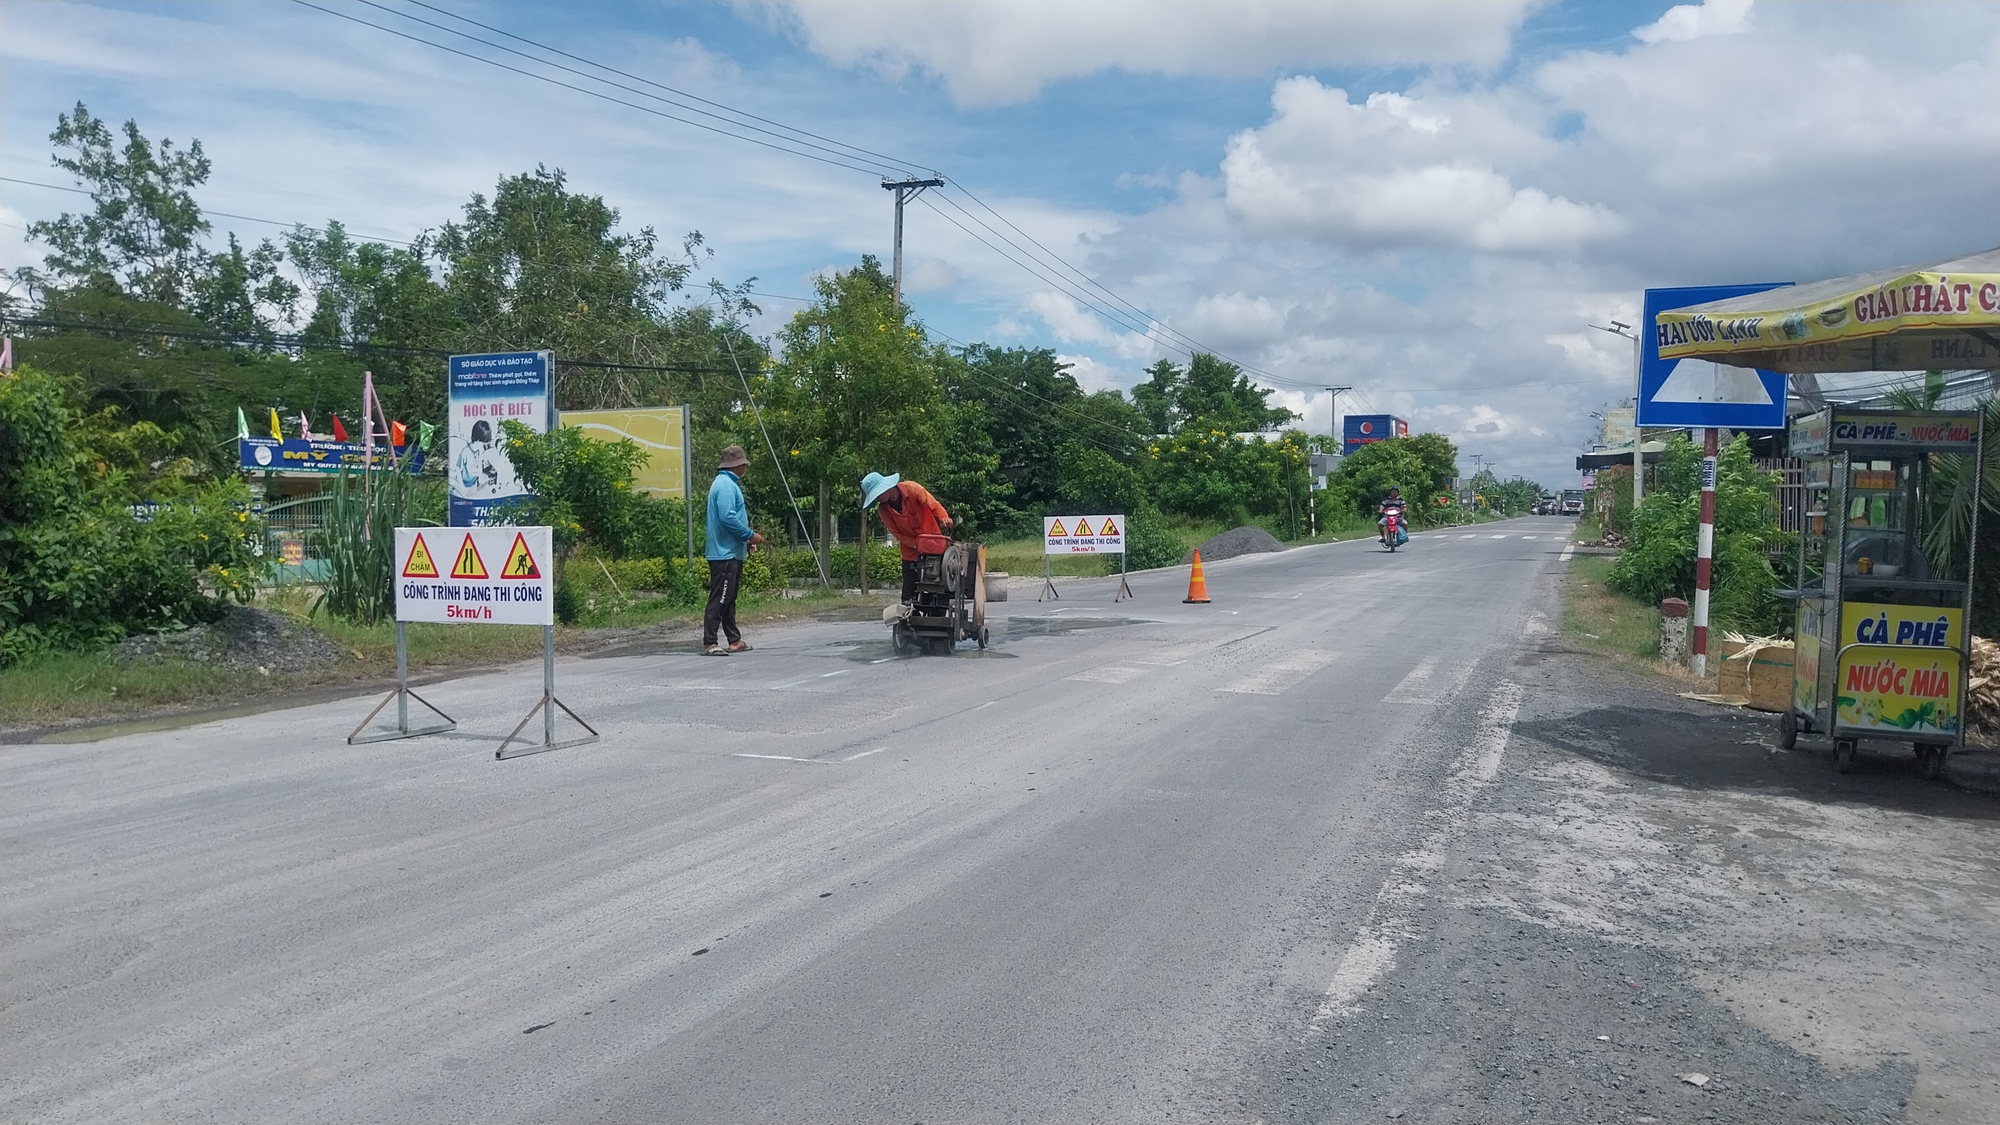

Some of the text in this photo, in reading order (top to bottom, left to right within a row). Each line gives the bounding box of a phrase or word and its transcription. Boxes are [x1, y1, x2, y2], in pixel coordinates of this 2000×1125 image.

[1902, 276, 1971, 312] KHÁT
[1979, 283, 2000, 310] C
[1686, 315, 1715, 342] ƯỚP
[1717, 318, 1764, 344] LẠNH
[464, 404, 486, 419] HỌC
[508, 397, 533, 416] BIẾT
[1836, 422, 1858, 439] CÀ
[1862, 422, 1897, 440] PHÊ
[1910, 424, 1946, 441] NƯỚC
[1948, 424, 1970, 441] MÍA
[310, 442, 345, 450] TRƯỜNG
[1064, 537, 1079, 545] TRÌNH
[411, 562, 430, 572] CHẬM
[404, 581, 542, 602] CÔNG TRÌNH ĐANG THI CÔNG
[447, 605, 492, 619] 5km/h
[1857, 612, 1949, 646] CÀ PHÊ
[1846, 658, 1908, 695] NƯỚC
[1909, 662, 1949, 698] MÍA
